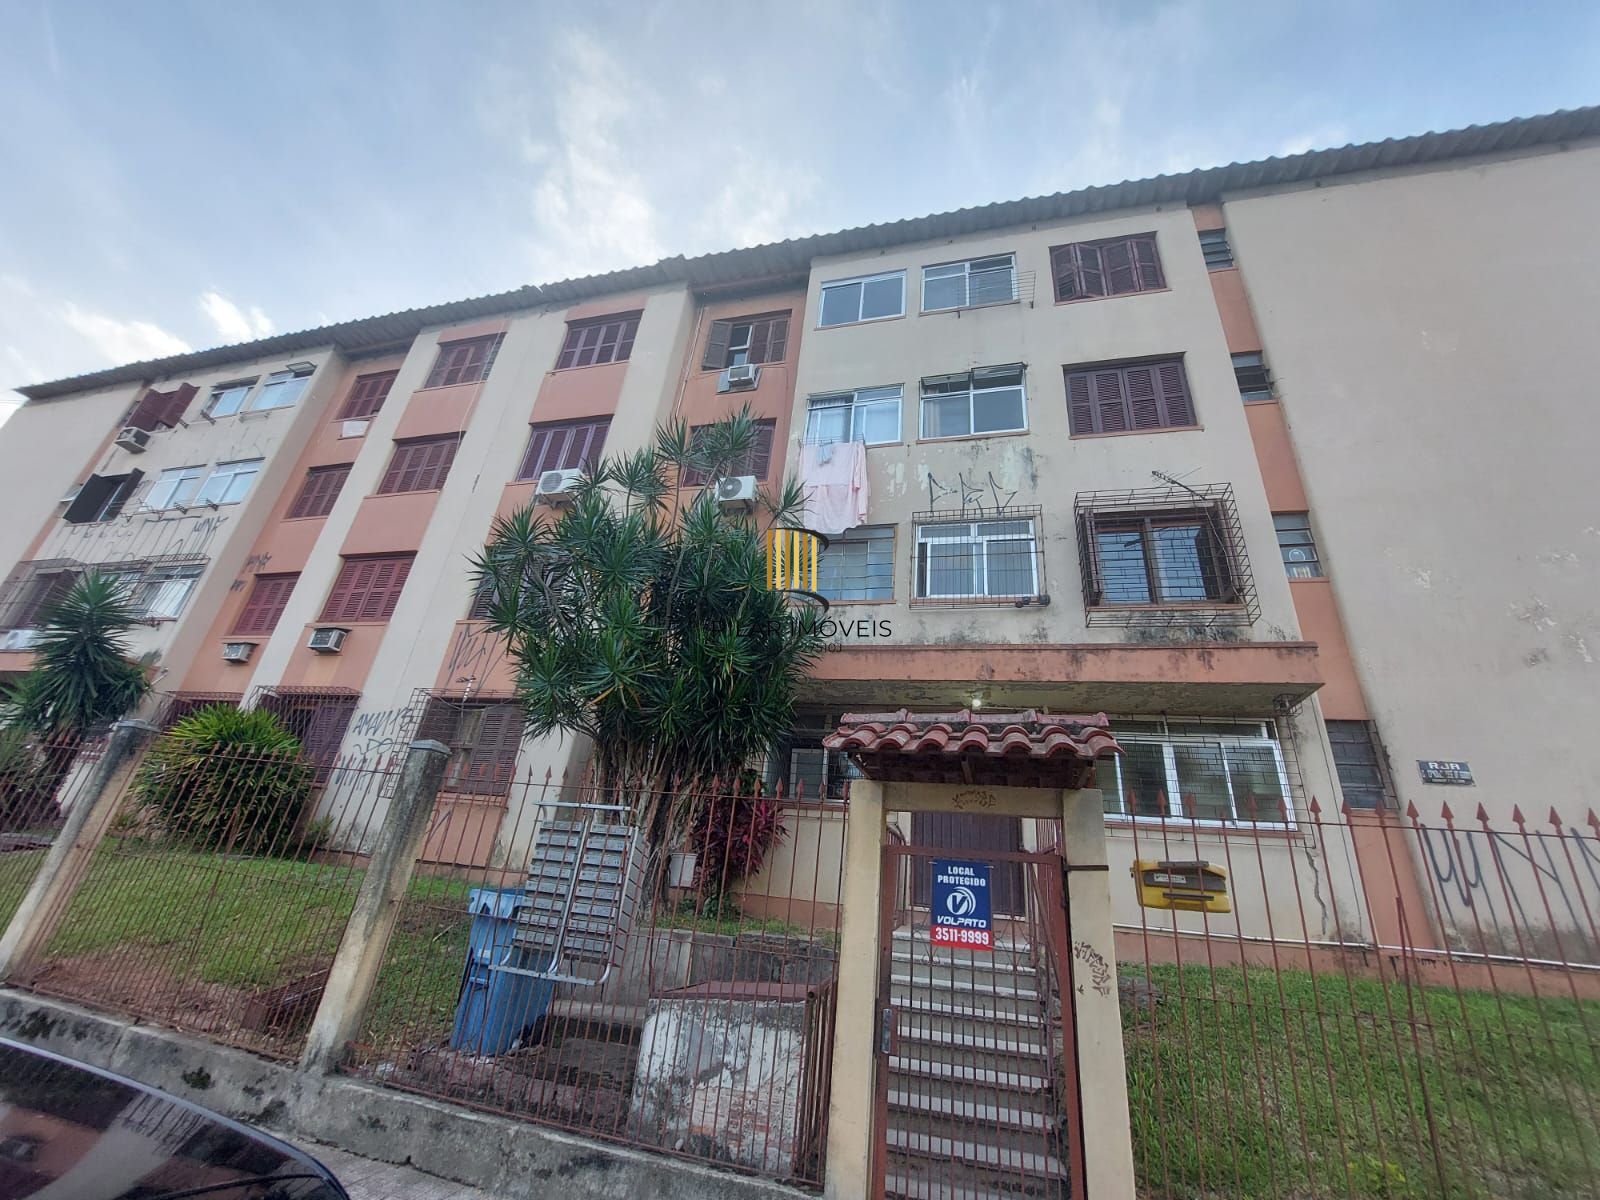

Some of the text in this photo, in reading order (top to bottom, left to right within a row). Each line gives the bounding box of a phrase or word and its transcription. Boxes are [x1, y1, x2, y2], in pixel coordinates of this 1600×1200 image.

[947, 866, 975, 876] LOCAL
[937, 875, 986, 887] PROTEGIDO
[937, 915, 987, 928] VOLPATO
[935, 927, 989, 945] 3511-9999
